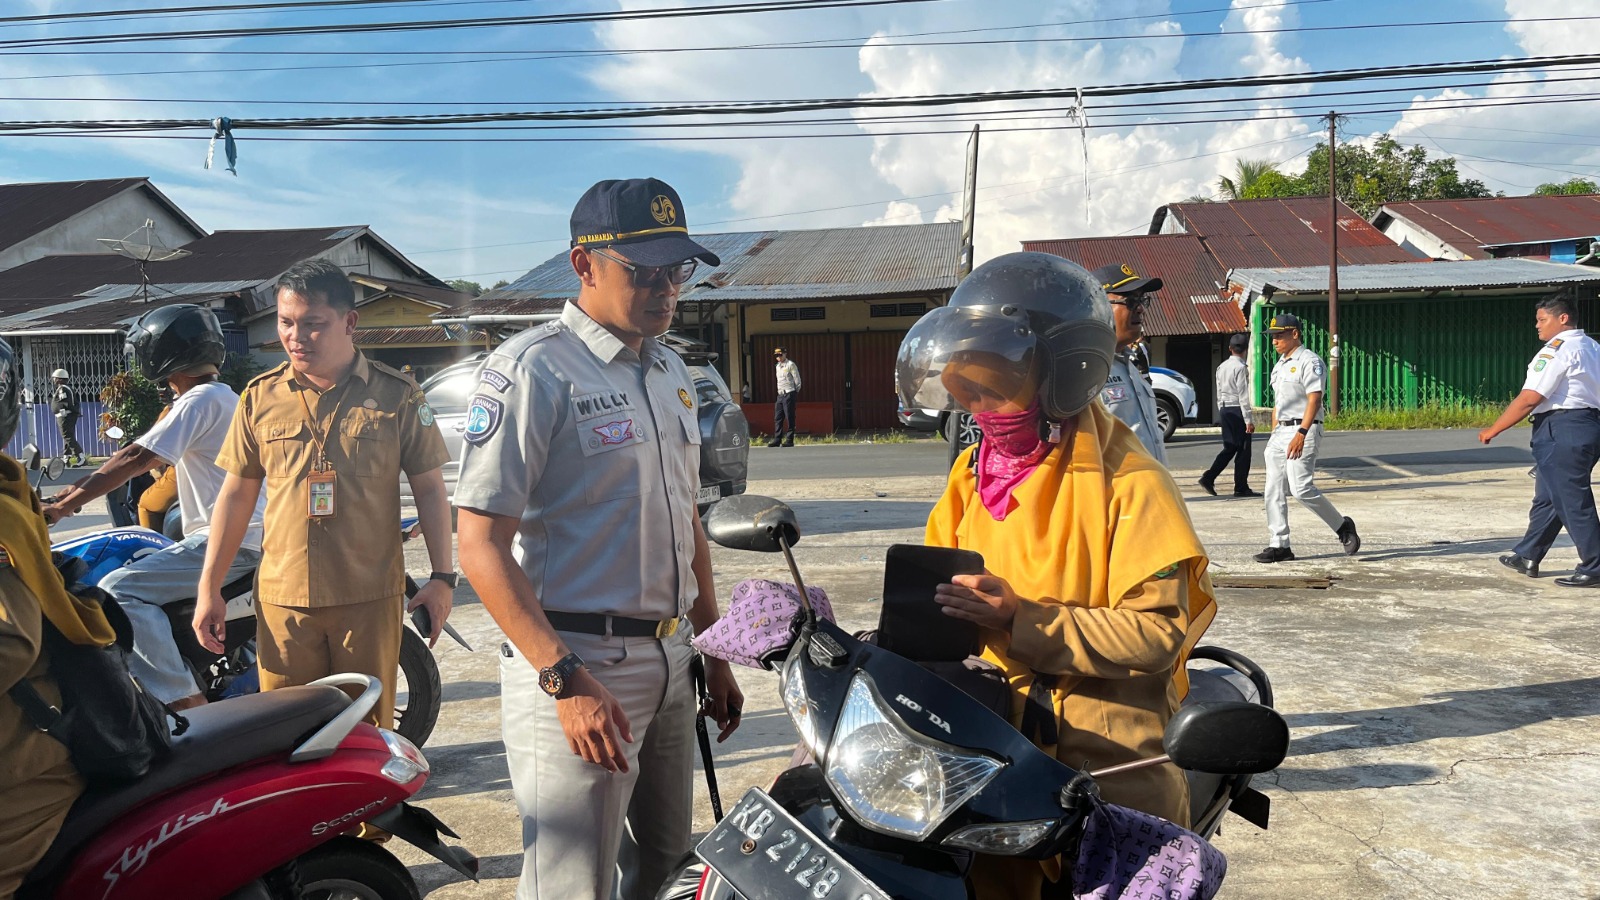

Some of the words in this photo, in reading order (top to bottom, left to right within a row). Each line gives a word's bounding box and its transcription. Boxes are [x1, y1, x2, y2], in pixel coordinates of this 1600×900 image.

[576, 393, 630, 416] WILLY
[116, 533, 163, 545] YAMAHA
[730, 797, 776, 840] KB
[765, 828, 842, 900] 2128
